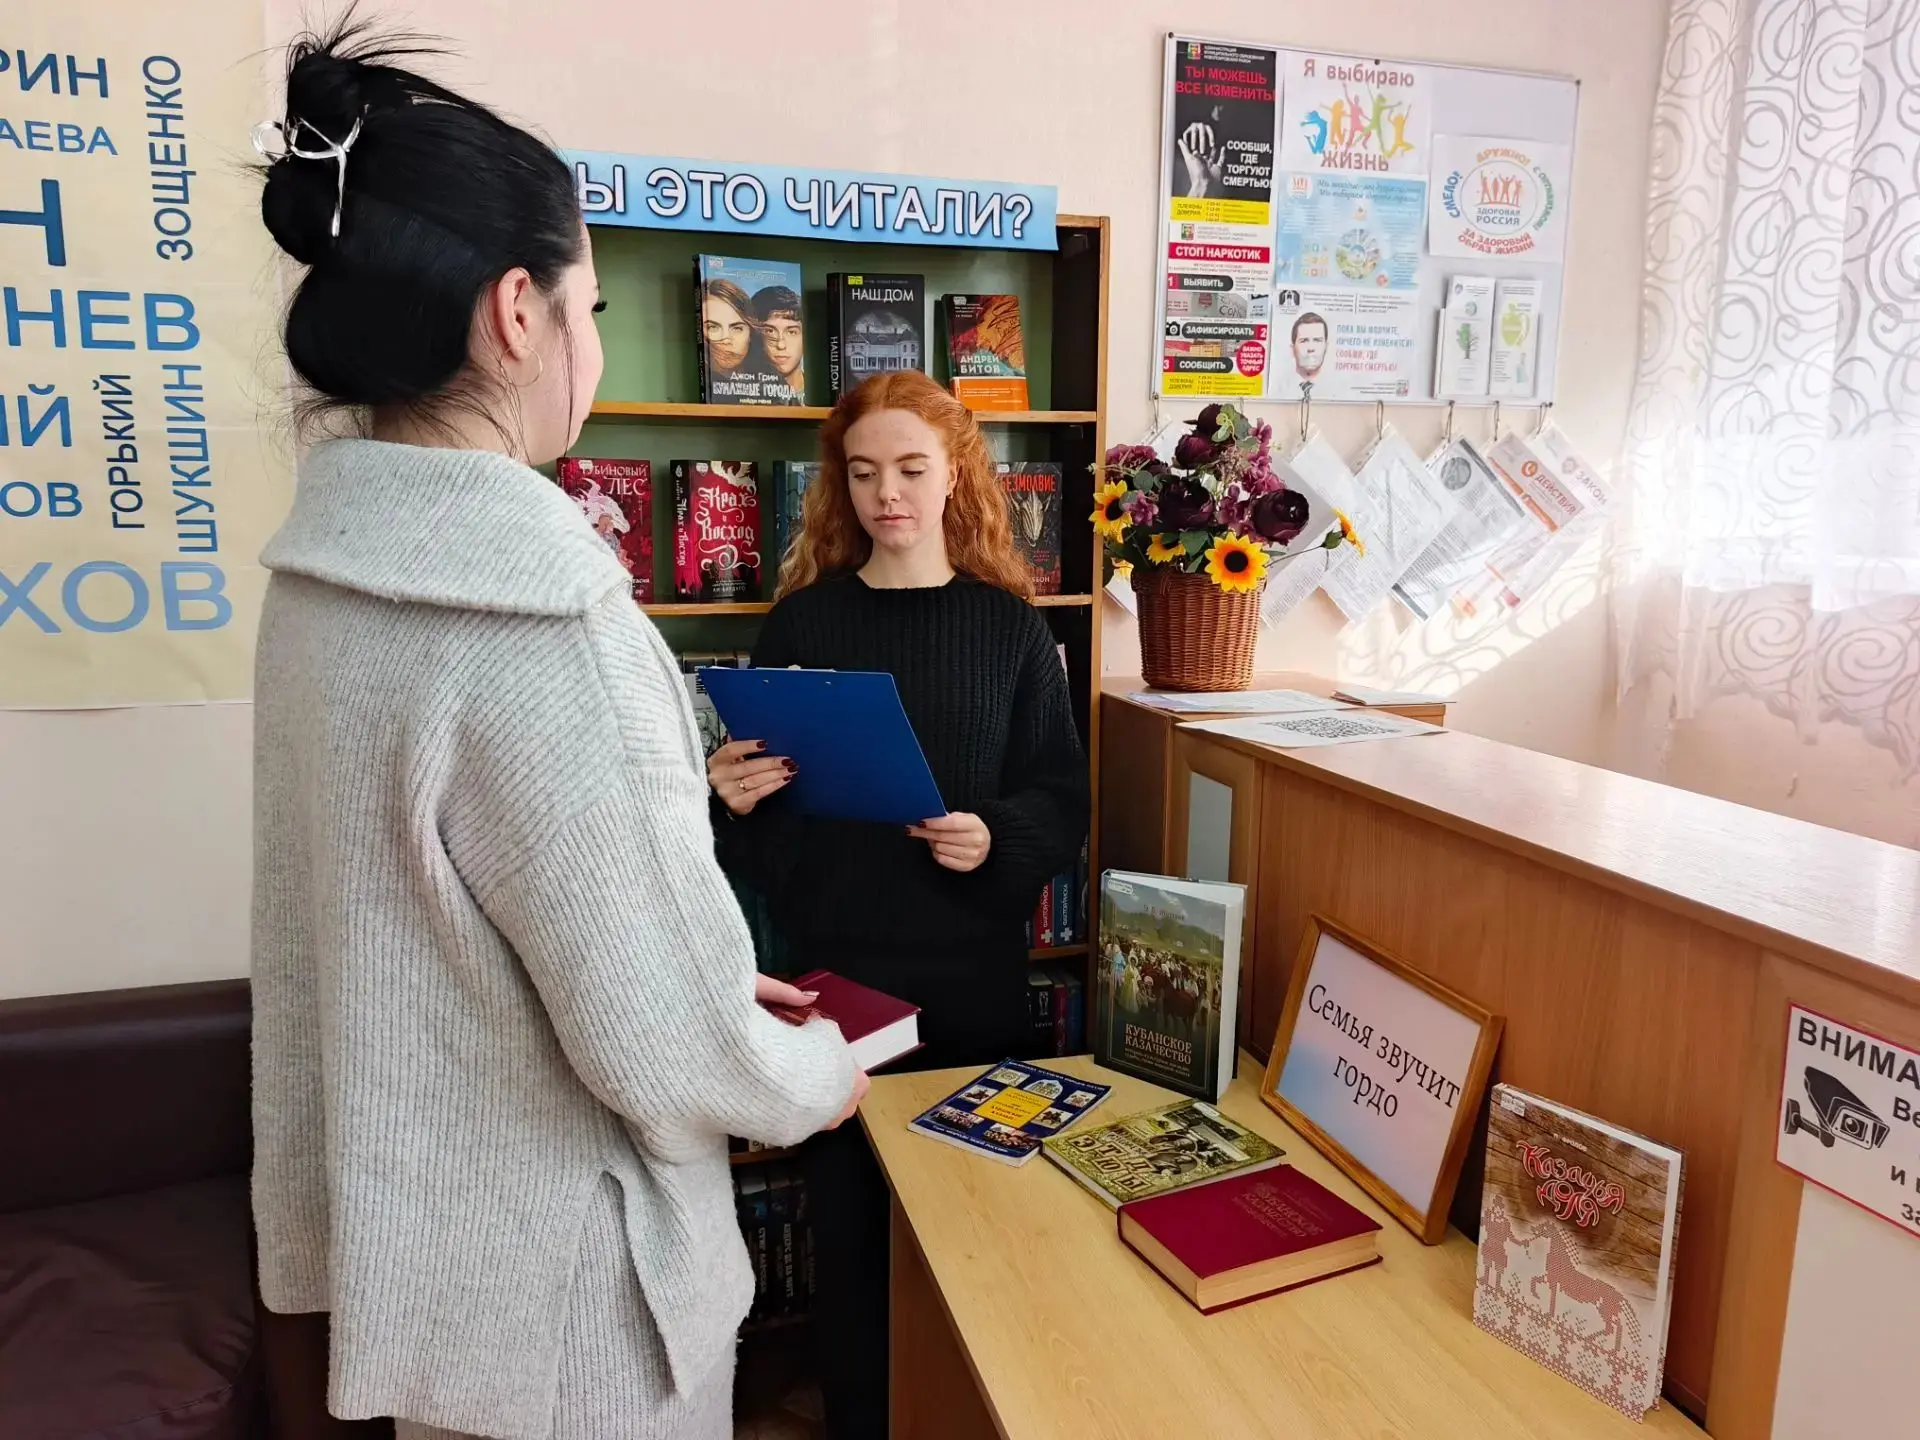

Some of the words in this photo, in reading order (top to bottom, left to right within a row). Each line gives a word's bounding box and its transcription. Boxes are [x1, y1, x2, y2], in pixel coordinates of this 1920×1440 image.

[1185, 66, 1205, 79] ТЫ
[1208, 67, 1268, 84] МОЖЕШЬ
[1304, 59, 1315, 77] Я
[1327, 64, 1415, 89] выбираю
[1175, 81, 1201, 94] ВСЕ
[1227, 140, 1272, 154] СООБЩИ,
[142, 55, 196, 261] ЗОЩЕНКО
[1240, 154, 1258, 164] ГДЕ
[1321, 150, 1389, 171] ЖИЗНЬ
[1227, 164, 1271, 177] ТОРГУЮТ
[645, 166, 767, 223] ЭТО
[784, 176, 1034, 239] ЧИТАЛИ?
[1476, 207, 1521, 217] ЗДОРОВАЯ
[1476, 215, 1521, 225] РОССИЯ
[1457, 234, 1492, 254] ОБРАЗ
[1495, 241, 1535, 255] ЖИЗНИ
[1462, 228, 1475, 240] ЗА
[1477, 232, 1532, 247] ЗДОРОВЫЙ
[1175, 246, 1204, 257] СТОП
[1206, 248, 1261, 260] НАРКОТИК
[1183, 278, 1224, 287] ВЫЯВИТЬ
[851, 288, 880, 300] НАШ
[883, 288, 914, 303] ДОМ
[3, 287, 201, 351] НЕВ
[1186, 326, 1254, 335] ЗАФИКСИРОВАТЬ
[1260, 327, 1267, 337] 2
[830, 336, 838, 362] НАШ
[960, 354, 1000, 364] АНДРЕЙ
[960, 365, 1000, 374] БИТОВ
[1163, 360, 1169, 370] 3
[1179, 360, 1226, 370] СООБЩИТЬ
[730, 371, 755, 381] Джон
[758, 372, 779, 382] Грин
[830, 365, 839, 390] ДОМ
[0, 384, 72, 447] Й
[92, 374, 146, 528] ГОРЬКИЙ
[162, 364, 218, 552] ШУКШИН
[603, 476, 648, 496] ЛЕС
[1534, 474, 1577, 516] ДЕЙСТВИЯ
[1575, 471, 1608, 506] ЗАКОН
[1125, 1023, 1192, 1054] КУБАНСКОЕ
[1308, 984, 1374, 1049] Семья
[1376, 1035, 1461, 1109] звучит
[1125, 1034, 1192, 1065] КАЗАЧЕСТВО
[1798, 1016, 1920, 1091] ВНИМА
[1333, 1055, 1398, 1118] гордо
[1890, 1164, 1906, 1186] и
